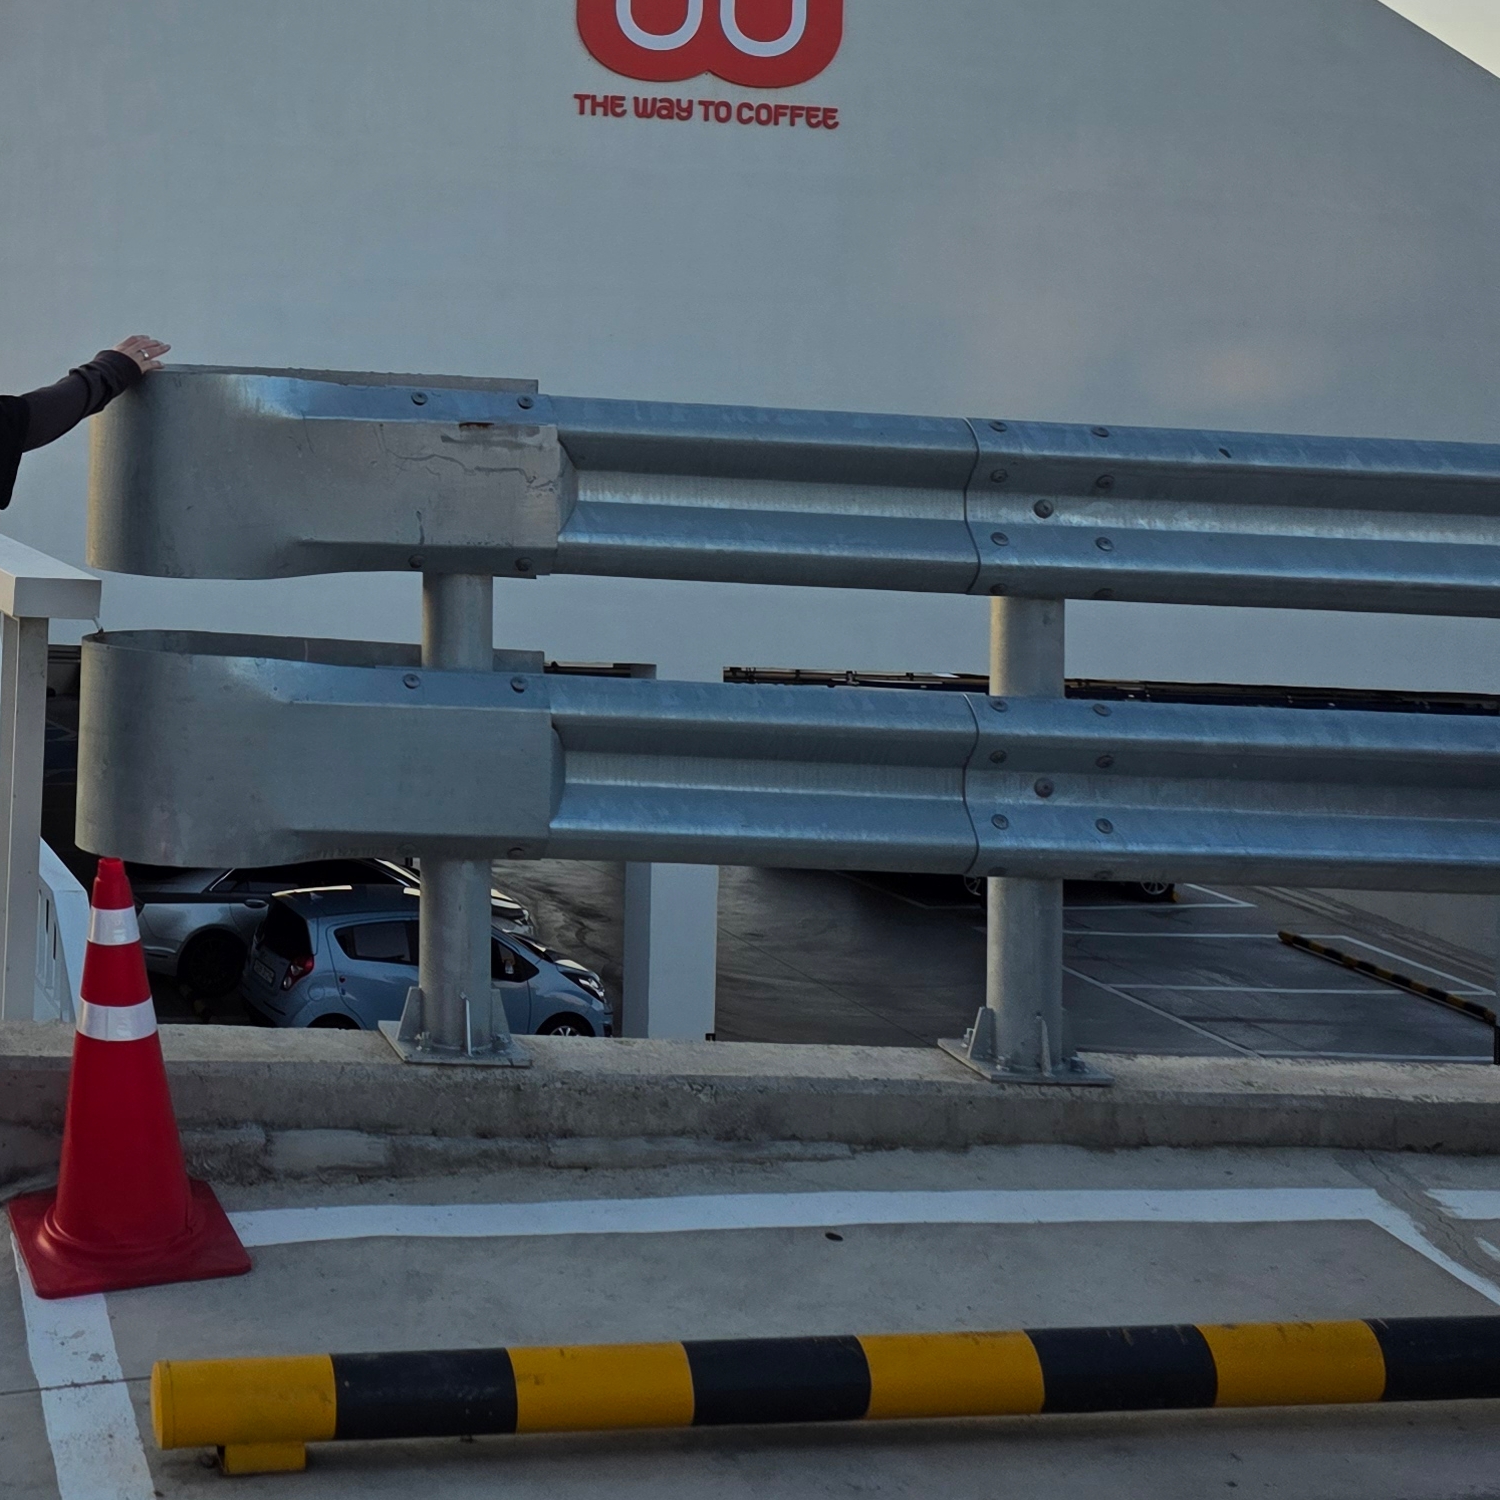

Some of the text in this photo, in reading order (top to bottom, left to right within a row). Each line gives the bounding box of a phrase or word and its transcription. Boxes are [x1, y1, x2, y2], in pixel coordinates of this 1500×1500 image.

[573, 93, 627, 118] THE
[698, 99, 732, 124] TO
[736, 101, 840, 130] COFFEE
